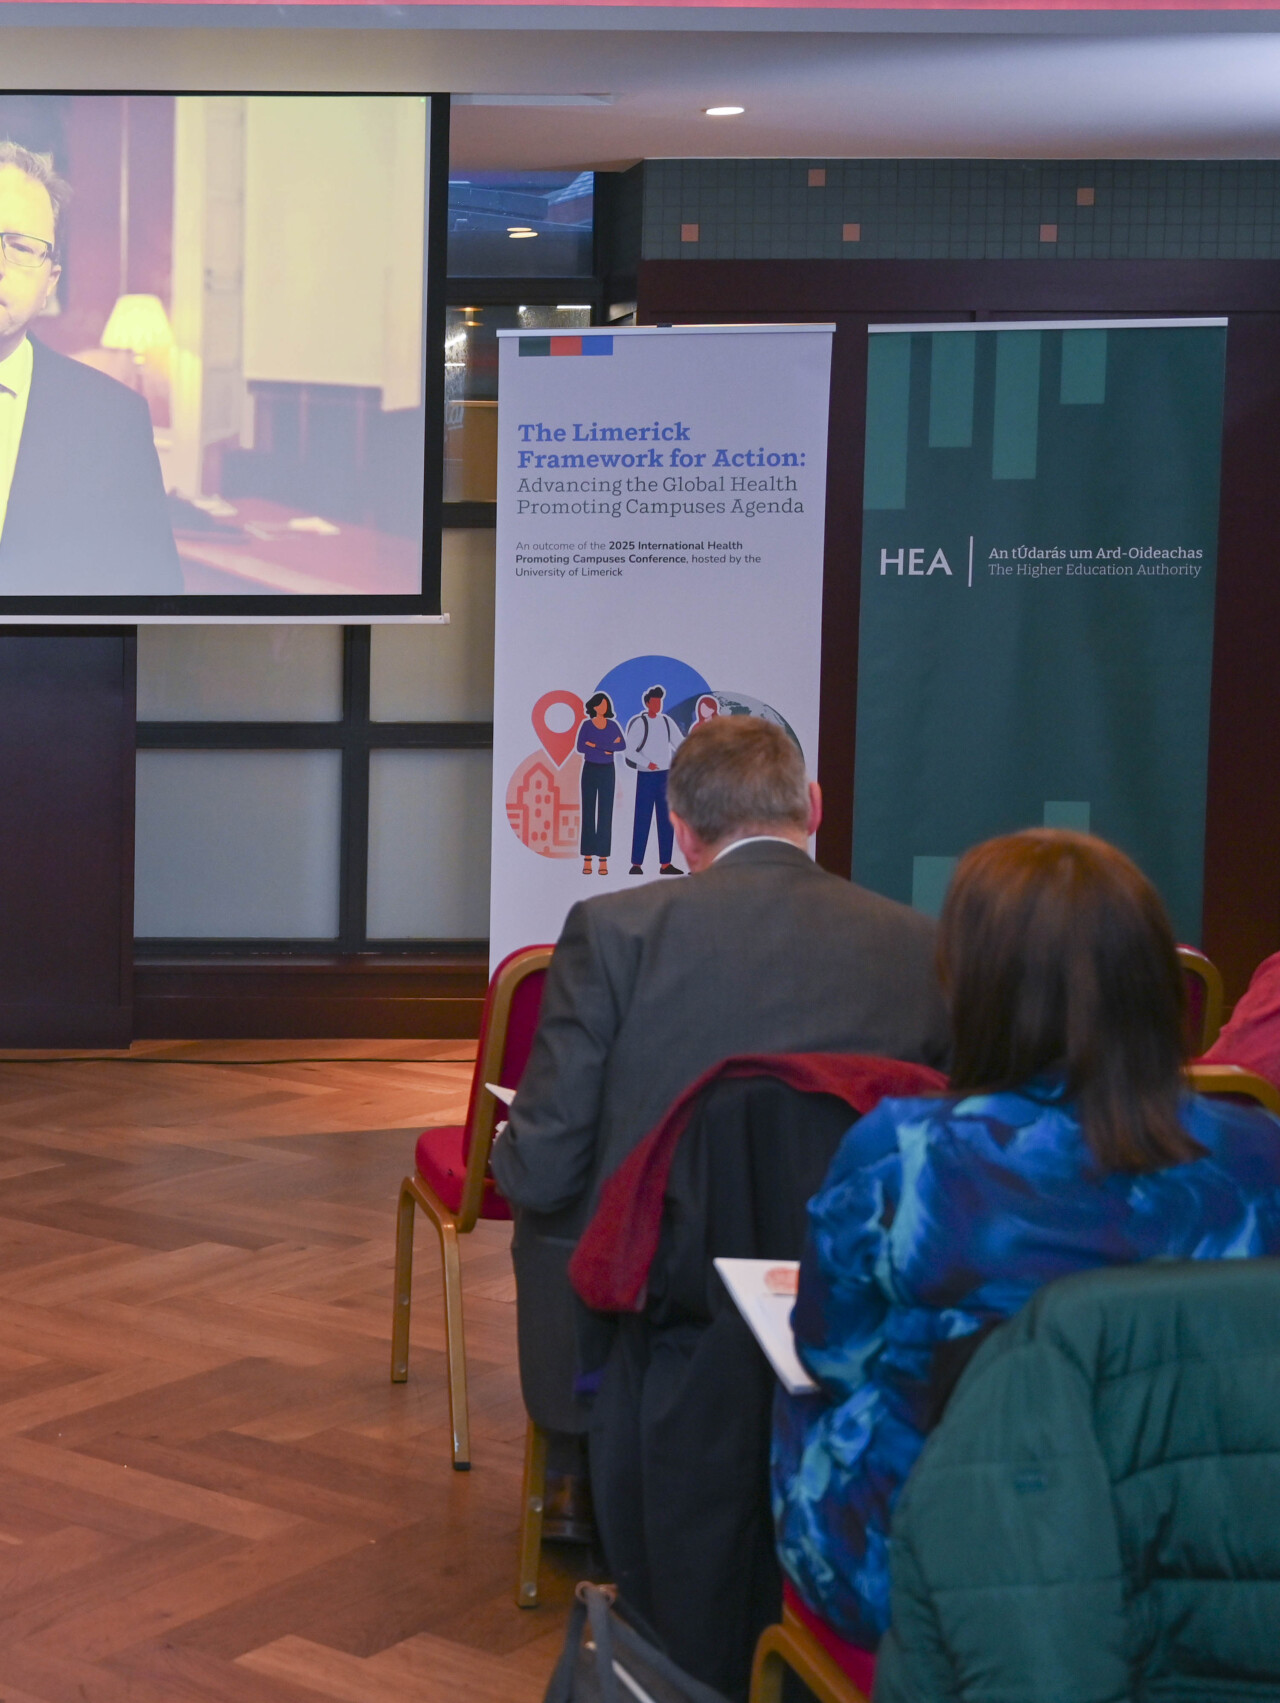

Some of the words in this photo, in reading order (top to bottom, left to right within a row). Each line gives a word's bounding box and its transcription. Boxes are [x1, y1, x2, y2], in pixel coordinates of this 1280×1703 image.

[518, 423, 567, 442] The
[572, 422, 691, 442] Limerick
[517, 448, 664, 469] Framework
[670, 448, 707, 468] for
[712, 447, 807, 467] Action:
[516, 477, 622, 496] Advancing
[626, 477, 658, 493] the
[662, 476, 725, 492] Global
[730, 476, 798, 492] Health
[516, 499, 622, 518] Promoting
[626, 499, 726, 518] Campuses
[730, 498, 804, 518] Agenda
[515, 541, 531, 551] An
[532, 543, 575, 551] outcome
[577, 541, 588, 550] of
[590, 541, 607, 550] the
[608, 541, 635, 550] 2025
[638, 541, 705, 550] International
[707, 541, 743, 550] Health
[989, 547, 1009, 559] An
[1011, 544, 1067, 560] tÚdarás
[1070, 550, 1094, 559] um
[1096, 547, 1203, 560] Ard-Oideachas
[515, 554, 570, 566] Promoting
[573, 554, 626, 566] Campuses
[628, 554, 689, 565] Conference,
[691, 554, 726, 564] hosted
[729, 554, 742, 566] by
[745, 554, 761, 564] the
[880, 548, 953, 576] HEA
[515, 567, 565, 579] University
[568, 567, 579, 577] of
[581, 567, 623, 577] Limerick
[988, 563, 1014, 576] The
[1017, 563, 1063, 579] Higher
[1066, 563, 1133, 576] Education
[1137, 563, 1202, 579] Authority
